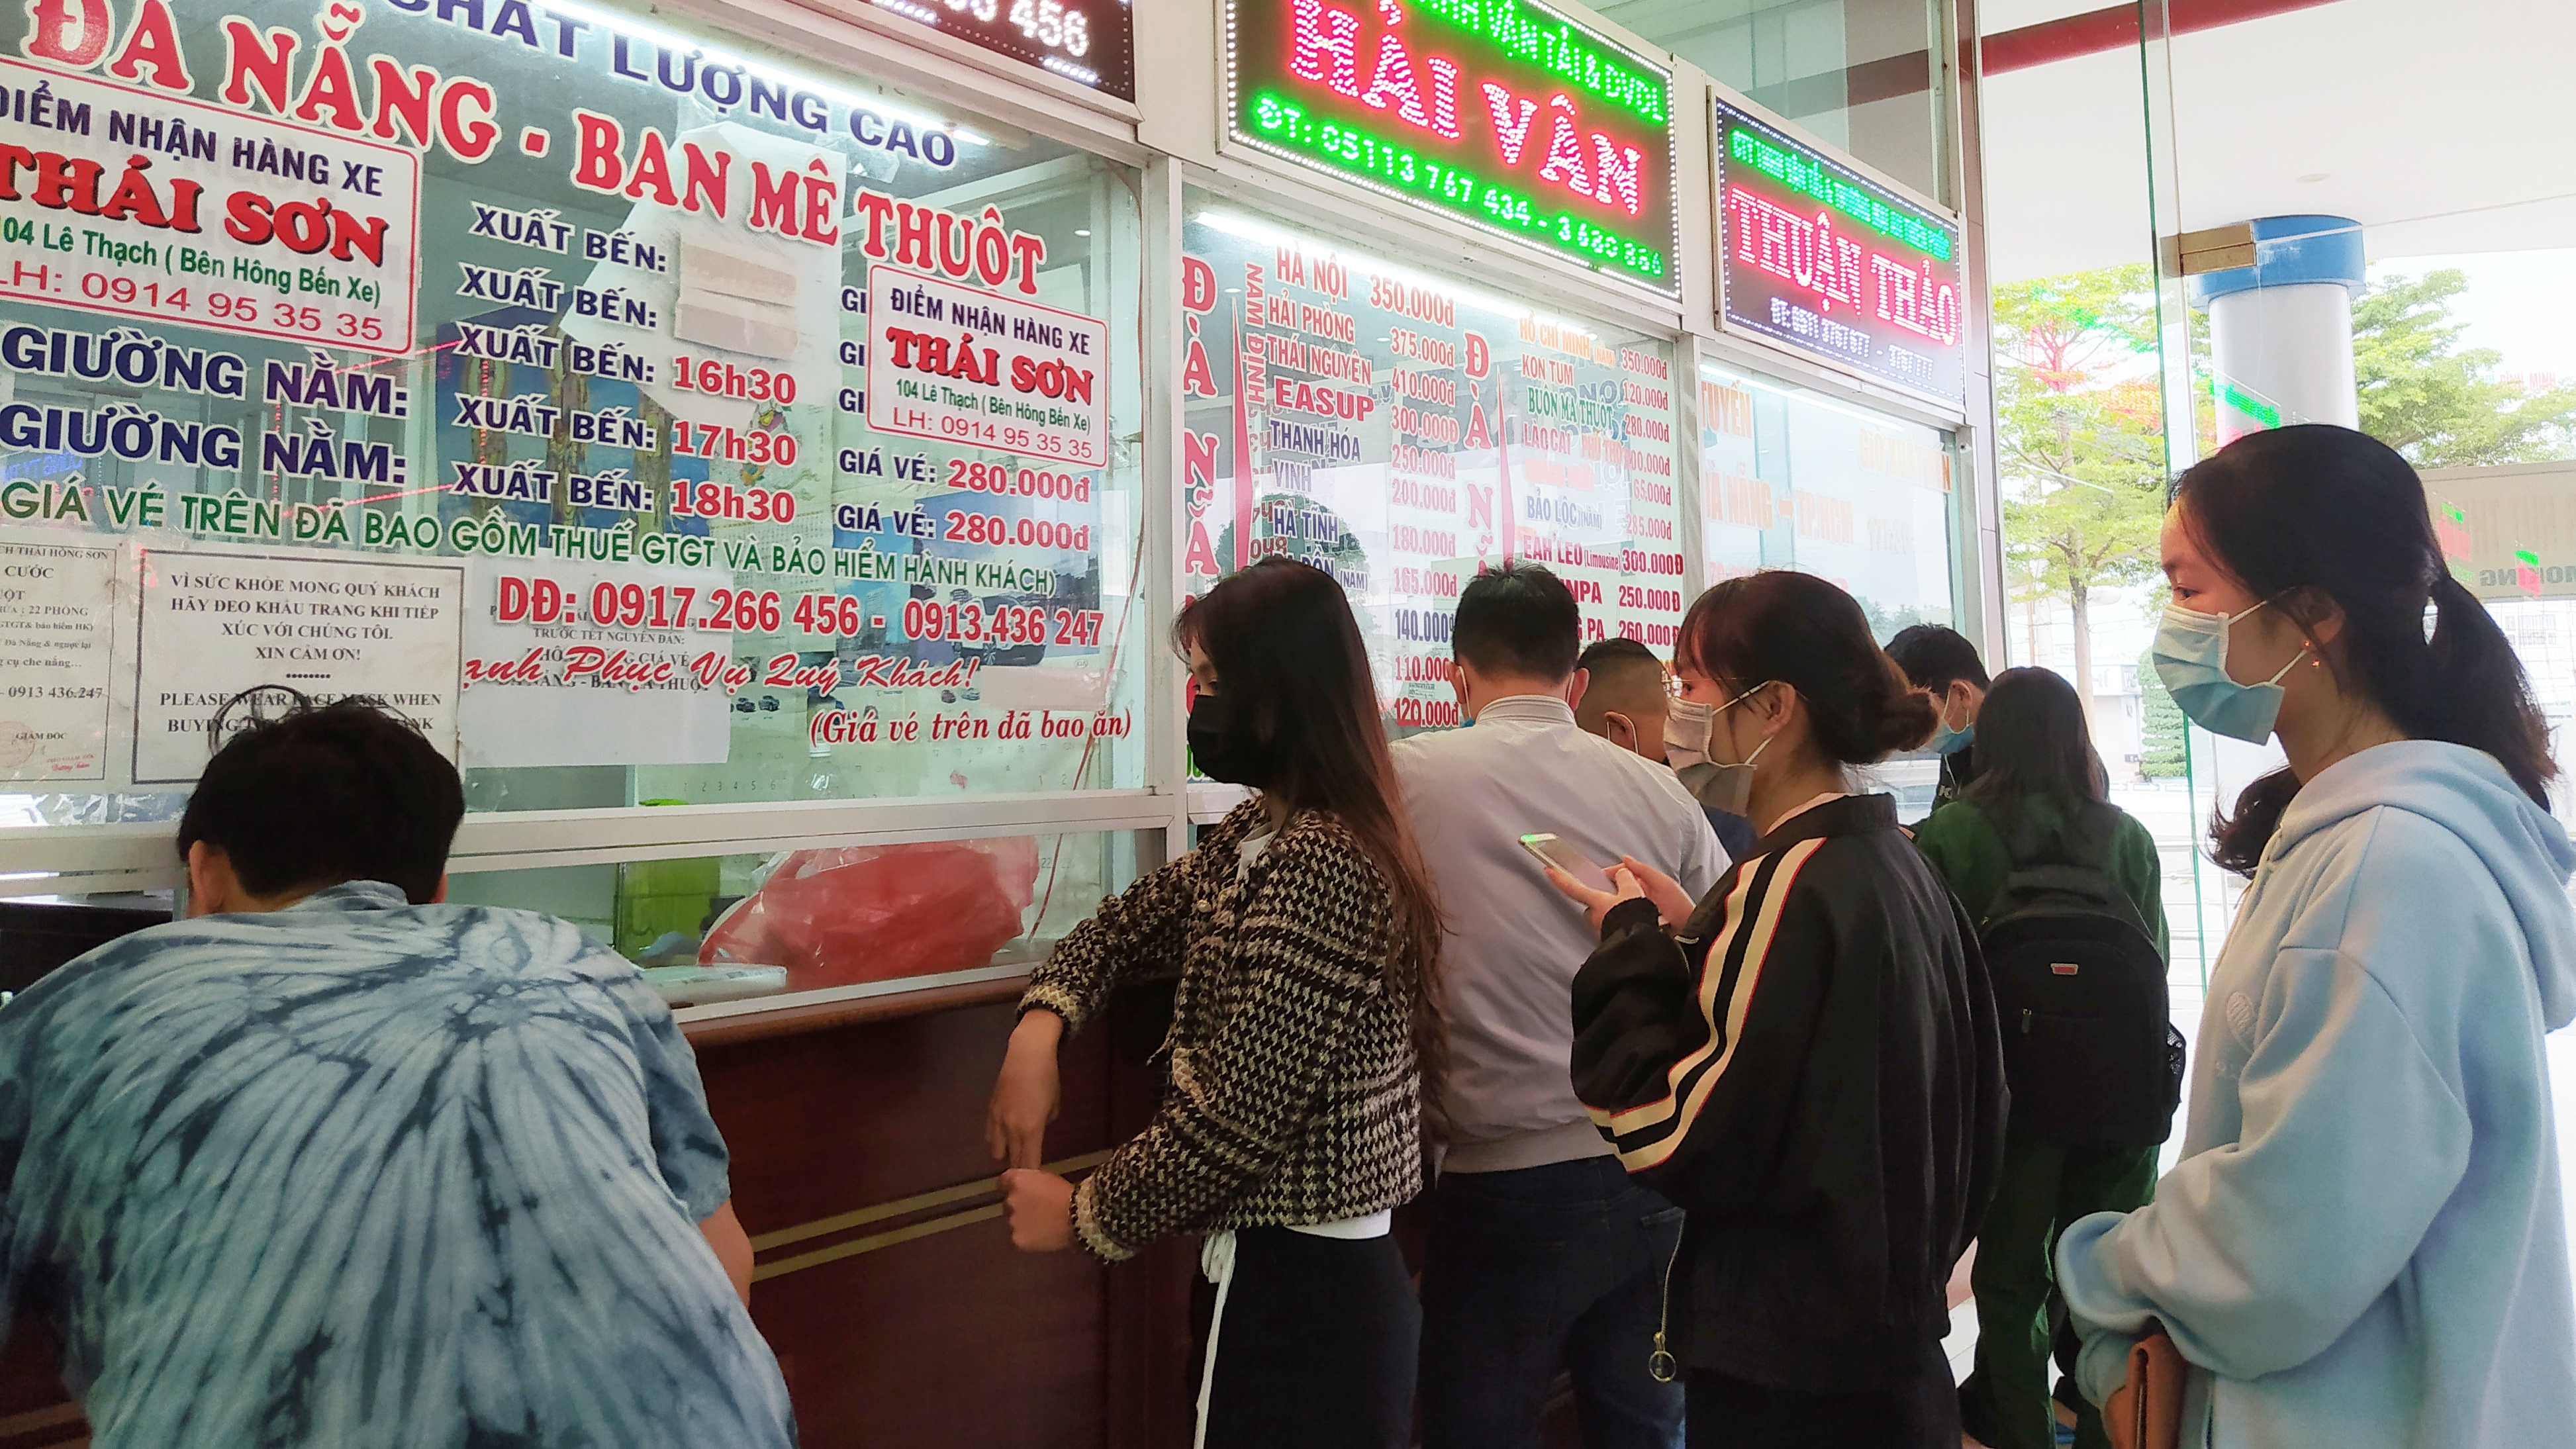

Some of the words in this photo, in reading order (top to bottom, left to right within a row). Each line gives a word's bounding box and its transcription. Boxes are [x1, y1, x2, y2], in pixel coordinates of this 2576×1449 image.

[224, 3, 497, 159] NẴNG
[577, 114, 729, 217] BAN
[750, 161, 838, 244] MÊ
[615, 37, 827, 132] LƯỢNG
[851, 108, 953, 166] CAO
[1291, 0, 1460, 138] HẢI
[1482, 83, 1641, 214] VÂN
[110, 110, 217, 161] NHẬN
[232, 136, 330, 185] HÀNG
[342, 161, 383, 197] XE
[1425, 164, 1472, 202] 767
[83, 230, 156, 265] Thạch
[224, 191, 389, 266] SƠN
[473, 205, 571, 251] XUẤT
[586, 232, 667, 271] BẾN:
[1731, 187, 1862, 316] THUẬN
[81, 272, 191, 311] 0914
[209, 293, 257, 321] 95
[273, 303, 321, 331] 35
[336, 314, 383, 340] 35
[461, 267, 560, 309] XUẤT
[576, 288, 657, 328] BẾN:
[1313, 252, 1348, 303] NỘI
[1370, 274, 1455, 328] 350.000đ
[891, 285, 943, 320] ĐIỂM
[952, 303, 1006, 337] NHẬN
[1014, 317, 1063, 348] HÀNG
[1069, 332, 1090, 355] XE
[1269, 289, 1296, 327] HẢI
[1302, 304, 1355, 343] PHÒNG
[1392, 328, 1455, 367] 375.000đ
[3, 326, 242, 396] GIƯỜNG
[459, 325, 559, 367] XUẤT
[573, 343, 653, 383] BẾN:
[675, 357, 795, 402] 16h30
[886, 326, 1000, 386] THÁI
[1012, 355, 1093, 406] SƠN
[1267, 336, 1305, 369] THÁI
[1311, 347, 1371, 385] NGUYÊN
[1392, 368, 1455, 405] 410.000đ
[1562, 331, 1590, 358] MINH
[1623, 349, 1668, 380] 350.000đ
[1276, 377, 1374, 421] EASUP
[1523, 354, 1545, 379] KON
[1549, 360, 1573, 386] TUM
[1624, 383, 1668, 410] 120.000đ
[1, 403, 239, 469] GIƯỜNG
[457, 397, 557, 435] XUẤT
[573, 407, 654, 449] BẾN:
[673, 421, 795, 466] 17h30
[941, 415, 996, 441] 0914
[1004, 428, 1029, 447] 95
[1036, 433, 1061, 452] 35
[1068, 439, 1092, 458] 35
[1529, 385, 1557, 417] BUÔN
[1562, 396, 1576, 422] MA
[1625, 414, 1669, 443] 280.000đ
[1270, 420, 1323, 455] THANH
[1330, 428, 1360, 461] HÓA
[1392, 444, 1455, 479] 250.000đ
[1550, 429, 1570, 455] CAI
[454, 462, 557, 500] XUẤT
[571, 469, 653, 511] BẾN:
[673, 482, 795, 522] 18h30
[839, 448, 883, 476] GIÁ
[948, 460, 1090, 503] 280.000đ
[1273, 462, 1312, 492] VINH
[1392, 479, 1455, 512] 200.000đ
[107, 483, 164, 527] VÉ
[181, 494, 280, 536] TRÊN
[297, 500, 349, 541] ĐÃ
[365, 514, 438, 548] BAO
[452, 509, 537, 555] GỒM
[551, 520, 637, 561] THUẾ
[642, 536, 716, 567] GTGT
[724, 536, 763, 571] VÀ
[772, 537, 826, 575] BẢO
[835, 539, 895, 580] HIỂM
[904, 549, 967, 585] HÀNH
[976, 559, 1056, 594] KHÁCH)
[838, 502, 883, 532] GIÁ
[945, 511, 1090, 551] 280.000đ
[1275, 504, 1296, 536] HÀ
[1302, 507, 1338, 541] TĨNH
[1394, 524, 1455, 557] 180.000đ
[1527, 489, 1550, 520] BẢO
[1555, 496, 1577, 528] LỘC
[1627, 514, 1672, 540] 285.000đ
[5, 564, 54, 578] CƯỚC
[171, 572, 189, 587] VÌ
[195, 573, 230, 589] SỨC
[290, 581, 340, 594] MONG
[345, 581, 377, 596] QUÝ
[384, 582, 440, 598] KHÁCH
[1341, 563, 1368, 591] (NẰM)
[1394, 566, 1456, 596] 165.000đ
[1584, 550, 1620, 572] (Limousine)
[1623, 549, 1683, 575] 300.000Đ
[29, 606, 40, 614] 22
[171, 596, 208, 611] HÃY
[215, 600, 250, 613] ĐEO
[311, 604, 365, 617] TRANG
[370, 606, 399, 618] KHI
[499, 577, 575, 622] DĐ:
[595, 583, 780, 632] 0917.266
[795, 594, 859, 635] 456
[904, 602, 1046, 645] 0913.436
[1055, 610, 1104, 646] 247
[1619, 585, 1680, 612] 250.000Đ
[222, 620, 258, 636] XÚC
[263, 621, 293, 637] VỚI
[298, 624, 358, 639] CHÚNG
[363, 624, 393, 639] TÔI.
[256, 646, 285, 659] XIN
[290, 645, 328, 660] CẢM
[332, 647, 361, 660] ƠN!
[534, 626, 578, 639] TRƯỚC
[581, 630, 602, 641] TẾT
[607, 631, 655, 643] NGUYÊN
[23, 658, 41, 667] che
[563, 647, 674, 692] Phục
[639, 650, 666, 664] GIÁ
[671, 652, 689, 667] VÉ
[9, 686, 43, 698] 0913
[48, 687, 103, 698] 436.247
[160, 693, 234, 706] PLEASE
[235, 693, 287, 706] WEAR
[393, 693, 441, 706] WHEN
[1395, 698, 1458, 726] 120.000đ
[890, 712, 918, 739] vé
[933, 711, 989, 739] trên
[1042, 710, 1084, 737] bao
